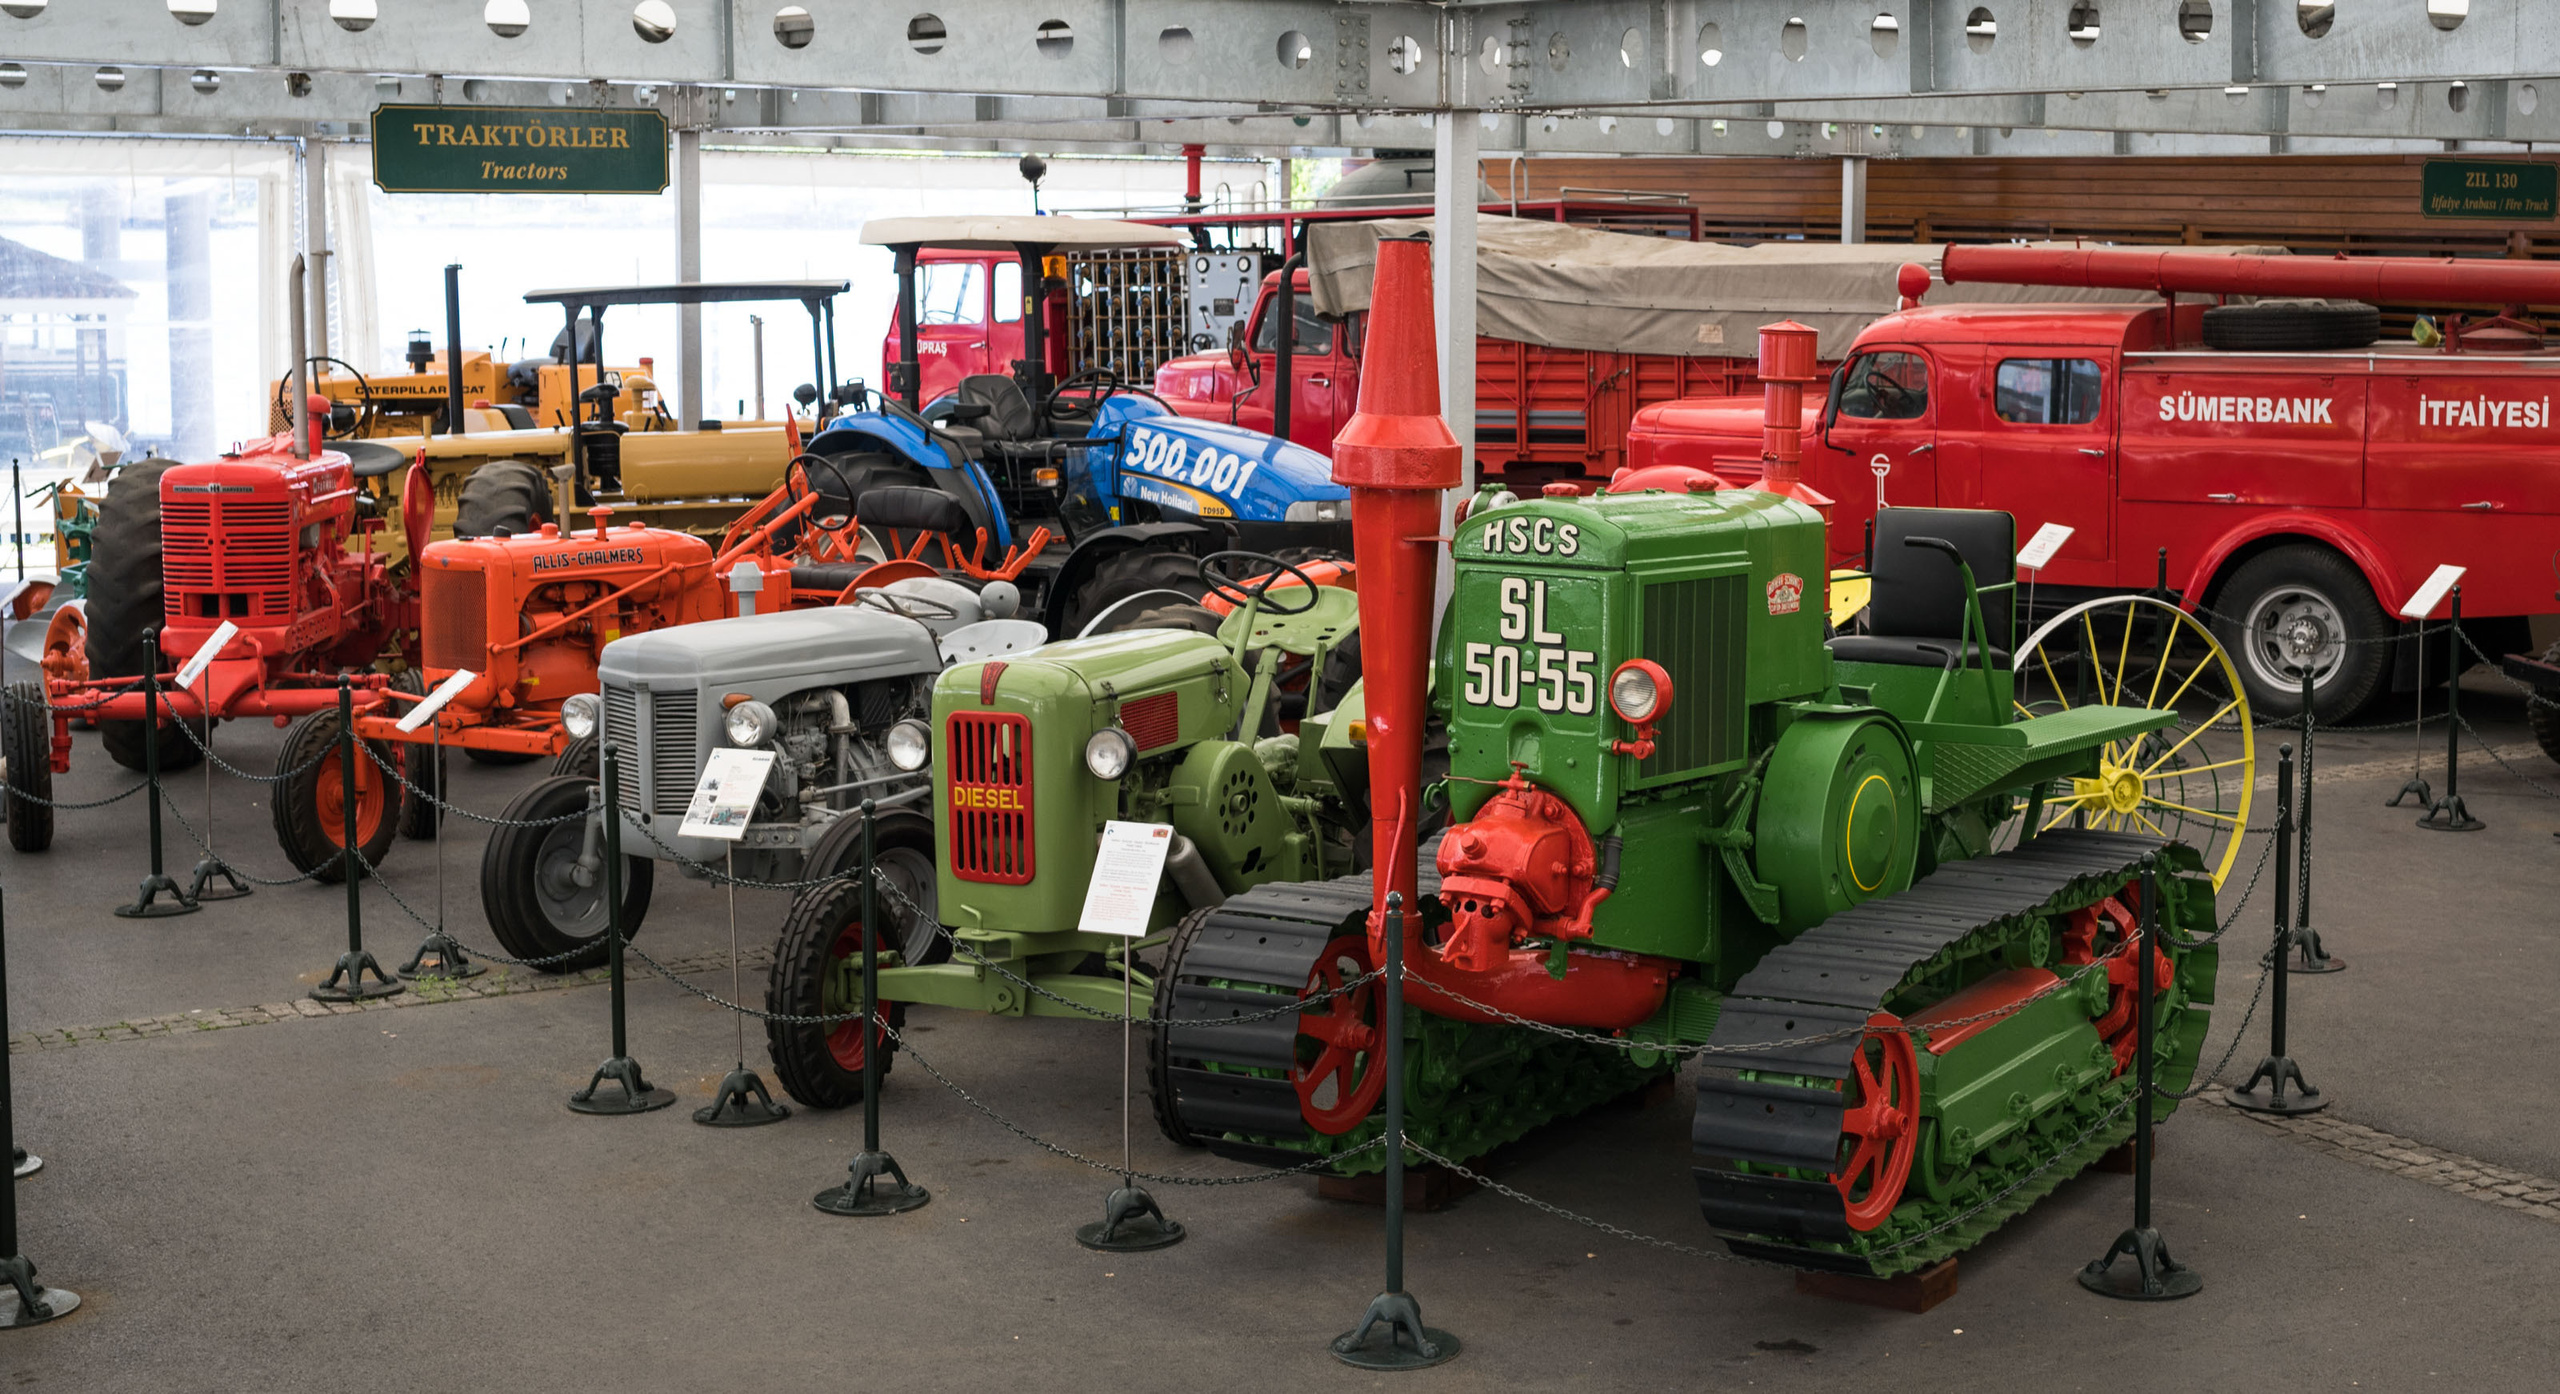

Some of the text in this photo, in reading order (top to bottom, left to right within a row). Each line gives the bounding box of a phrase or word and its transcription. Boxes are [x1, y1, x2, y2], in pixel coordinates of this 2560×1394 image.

[413, 119, 630, 149] TRAKTÖRLER
[481, 160, 569, 181] Tractors
[2465, 172, 2518, 189] ZIL 130
[2505, 199, 2523, 211] Fire
[2525, 199, 2550, 211] Truck
[916, 339, 948, 358] ÜPRAŞ
[2159, 391, 2333, 424] SÜMERBANK
[2419, 394, 2549, 428] İTFAİYESİ
[1125, 427, 1258, 500] 500.001
[1140, 485, 1193, 511] New Holland
[1203, 506, 1225, 515] TD95D
[1483, 516, 1579, 555] HSCS
[533, 547, 644, 573] ALLIS-CHALMERS
[1500, 577, 1563, 645] SL
[1464, 641, 1595, 715] 50-55
[954, 786, 1024, 809] DIESEL
